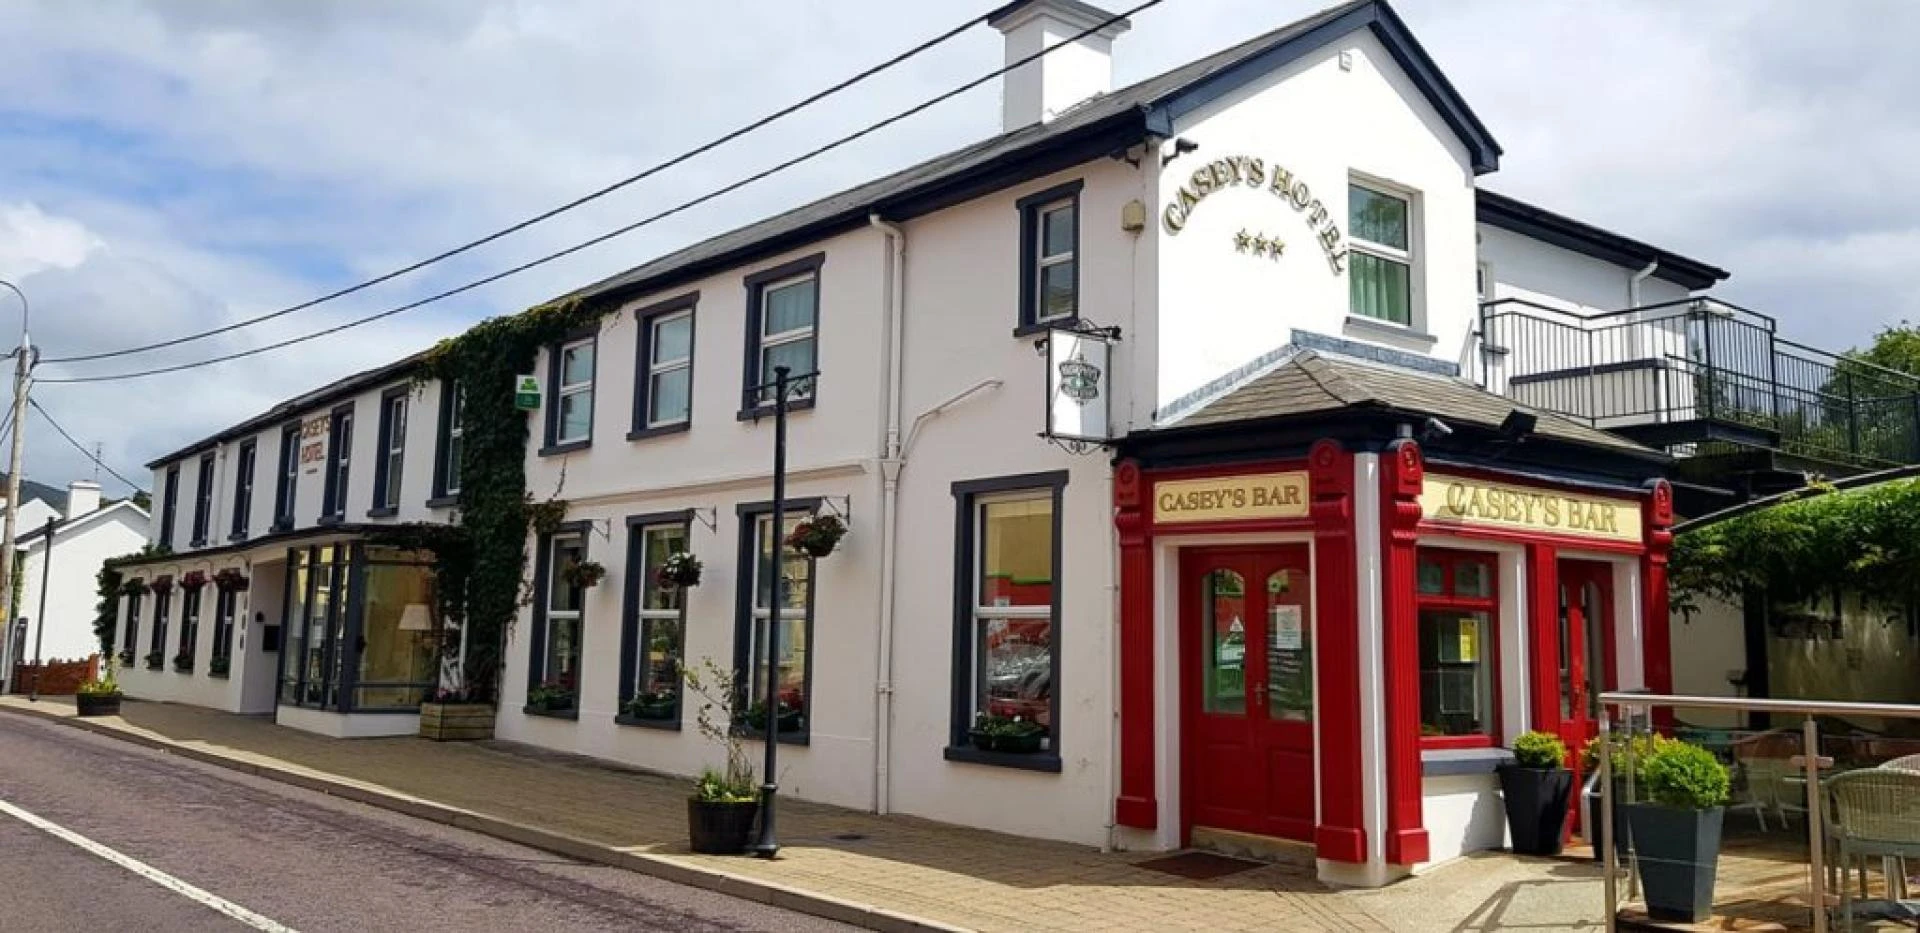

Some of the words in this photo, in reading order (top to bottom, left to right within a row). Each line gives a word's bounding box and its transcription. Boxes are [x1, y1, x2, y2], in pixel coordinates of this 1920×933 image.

[1162, 155, 1265, 236] CASEY'S
[1269, 163, 1348, 275] HOTEL
[301, 441, 325, 463] HOTEL
[1158, 489, 1246, 512] CASEY'S
[1252, 484, 1302, 507] BAR
[1446, 483, 1559, 527] CASEY'S
[1568, 499, 1617, 533] BAR
